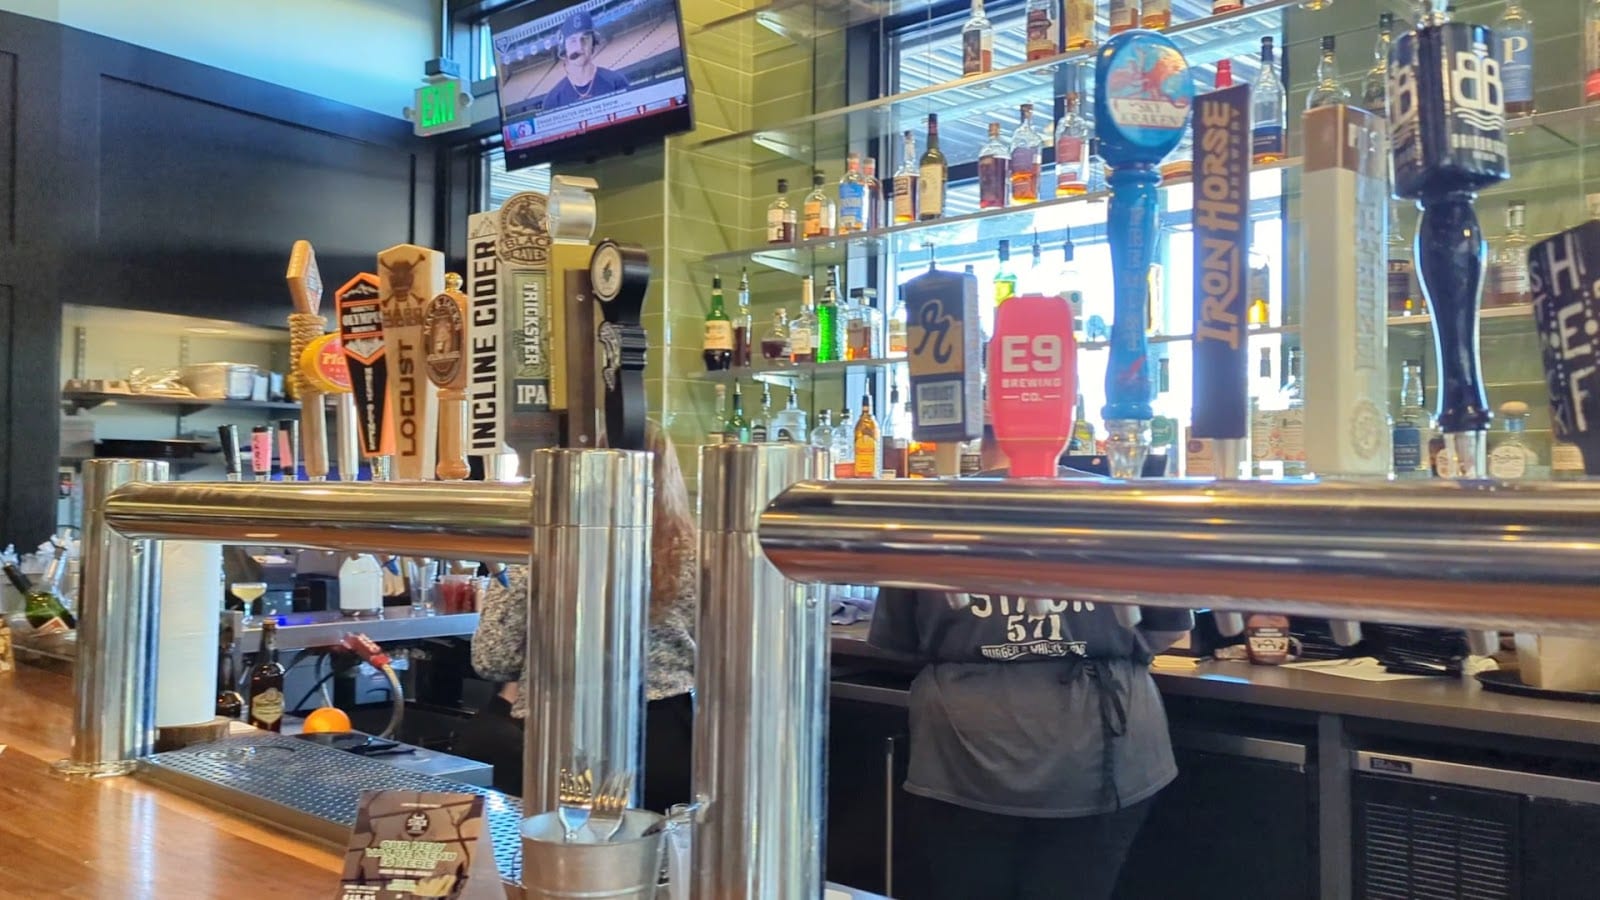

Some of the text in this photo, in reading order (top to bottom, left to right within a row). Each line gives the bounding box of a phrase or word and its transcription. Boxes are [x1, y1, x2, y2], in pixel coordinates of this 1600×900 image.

[1501, 36, 1528, 65] P
[422, 81, 455, 127] EXIT
[1196, 101, 1240, 350] IRON HORSE
[473, 240, 497, 449] INCLINE CIDER
[523, 281, 540, 367] TRICKSTER
[1001, 334, 1062, 373] E9
[398, 339, 417, 456] LOCUST
[517, 384, 548, 405] IPA
[1001, 378, 1062, 388] BREWING
[1007, 614, 1063, 642] 571
